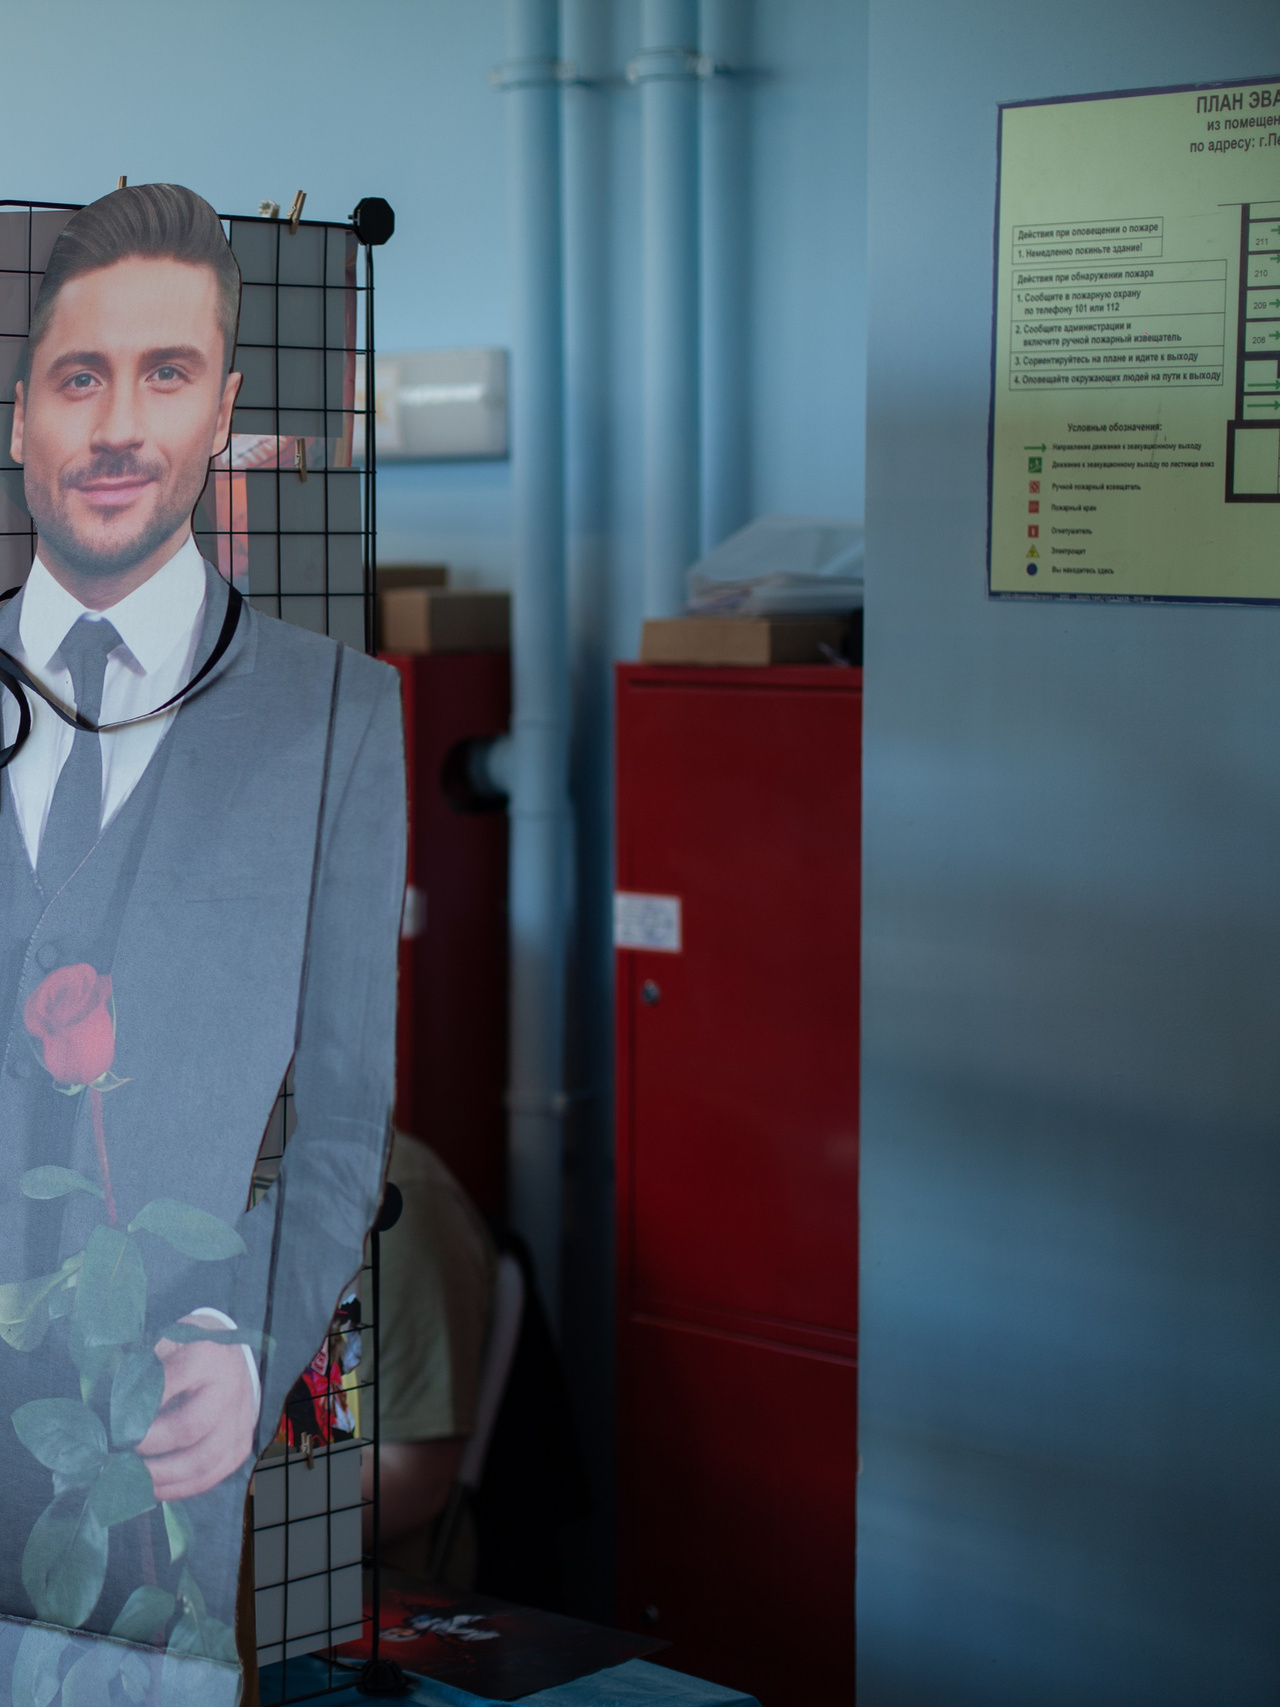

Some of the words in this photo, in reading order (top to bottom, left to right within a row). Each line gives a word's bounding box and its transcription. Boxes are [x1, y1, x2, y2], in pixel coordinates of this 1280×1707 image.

[1196, 92, 1243, 114] ПЛАН
[1206, 120, 1221, 131] из
[1190, 141, 1205, 153] по
[1208, 137, 1255, 153] адресу:
[1018, 229, 1054, 241] Действия
[1055, 228, 1070, 239] при
[1071, 225, 1120, 236] оповещении
[1129, 223, 1159, 234] пожаре
[1255, 238, 1269, 246] 211
[1026, 247, 1073, 259] Немедленно
[1075, 245, 1111, 256] покиньте
[1017, 273, 1053, 285] Действия
[1055, 272, 1069, 283] при
[1071, 270, 1123, 282] обнаружении
[1124, 269, 1154, 280] пожара
[1254, 269, 1268, 278] 210
[1024, 292, 1063, 303] Сообщите
[1072, 291, 1111, 302] пожарную
[1113, 289, 1142, 300] охрану
[1024, 307, 1034, 315] по
[1036, 304, 1073, 315] телефону
[1106, 302, 1120, 312] 112
[1253, 301, 1267, 310] 209
[1023, 323, 1062, 334] Сообщите
[1064, 322, 1124, 333] администрации
[1023, 337, 1060, 347] включите
[1061, 335, 1089, 347] ручной
[1091, 334, 1132, 346] пожарный
[1133, 333, 1182, 344] извещатель
[1252, 336, 1266, 345] 208
[1022, 354, 1090, 367] Сориентируйтесь
[1091, 355, 1101, 363] на
[1103, 354, 1126, 363] плане
[1135, 353, 1159, 363] идите
[1167, 351, 1198, 362] выходу
[1021, 374, 1070, 385] Оповещайте
[1071, 374, 1121, 384] окружающих
[1122, 372, 1149, 383] людей
[1150, 373, 1161, 381] на
[1162, 372, 1181, 382] пути
[1189, 370, 1221, 381] выходу
[1067, 422, 1107, 433] Условные
[1108, 422, 1162, 432] обозначения:
